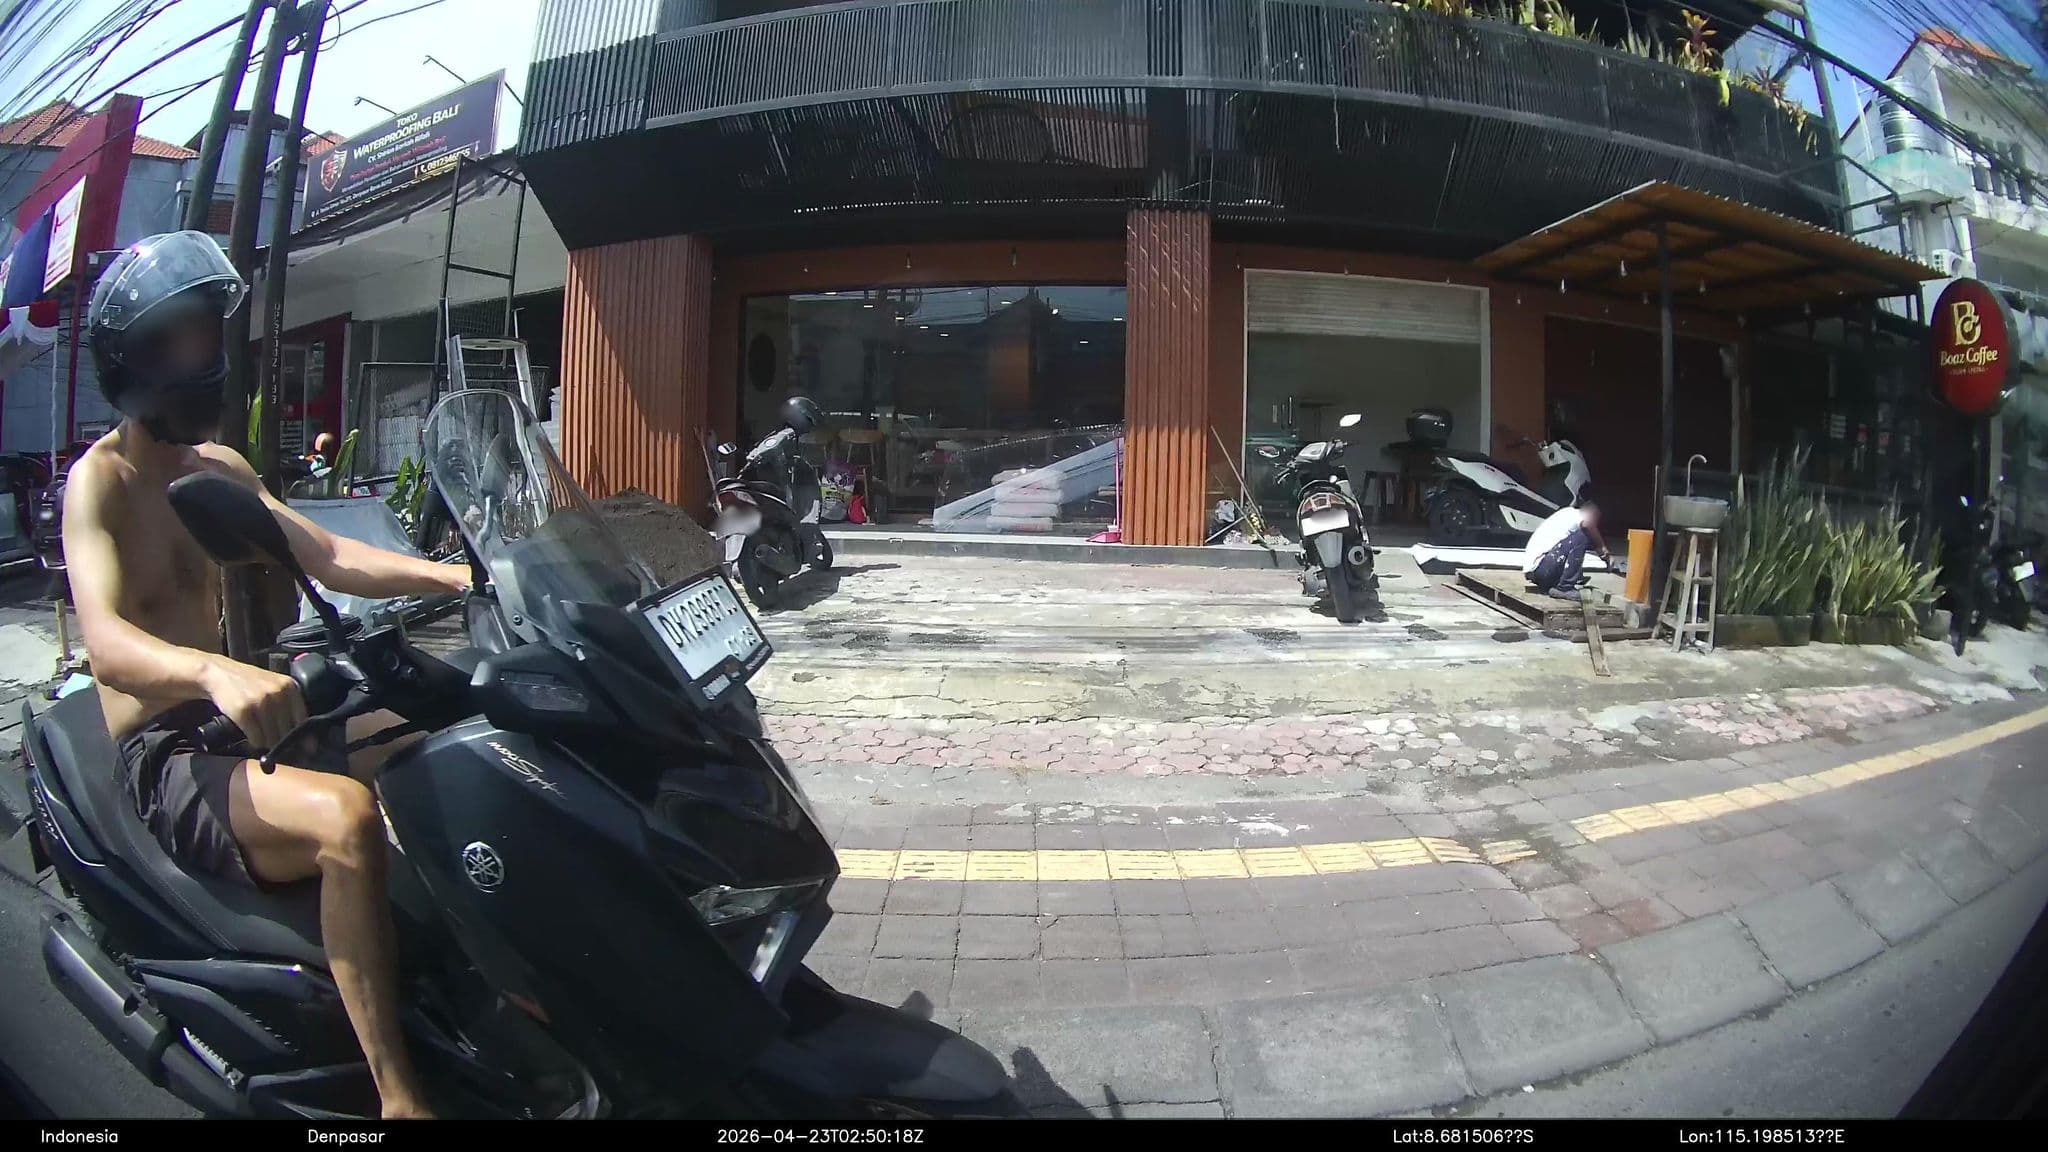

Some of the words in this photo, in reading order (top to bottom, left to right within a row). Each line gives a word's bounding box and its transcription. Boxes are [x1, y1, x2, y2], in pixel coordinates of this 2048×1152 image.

[353, 116, 432, 160] WATERPROOFING
[432, 103, 461, 126] BALI
[397, 112, 418, 129] TOKO
[1940, 350, 1965, 367] Boaz
[1966, 345, 1999, 366] Coffee
